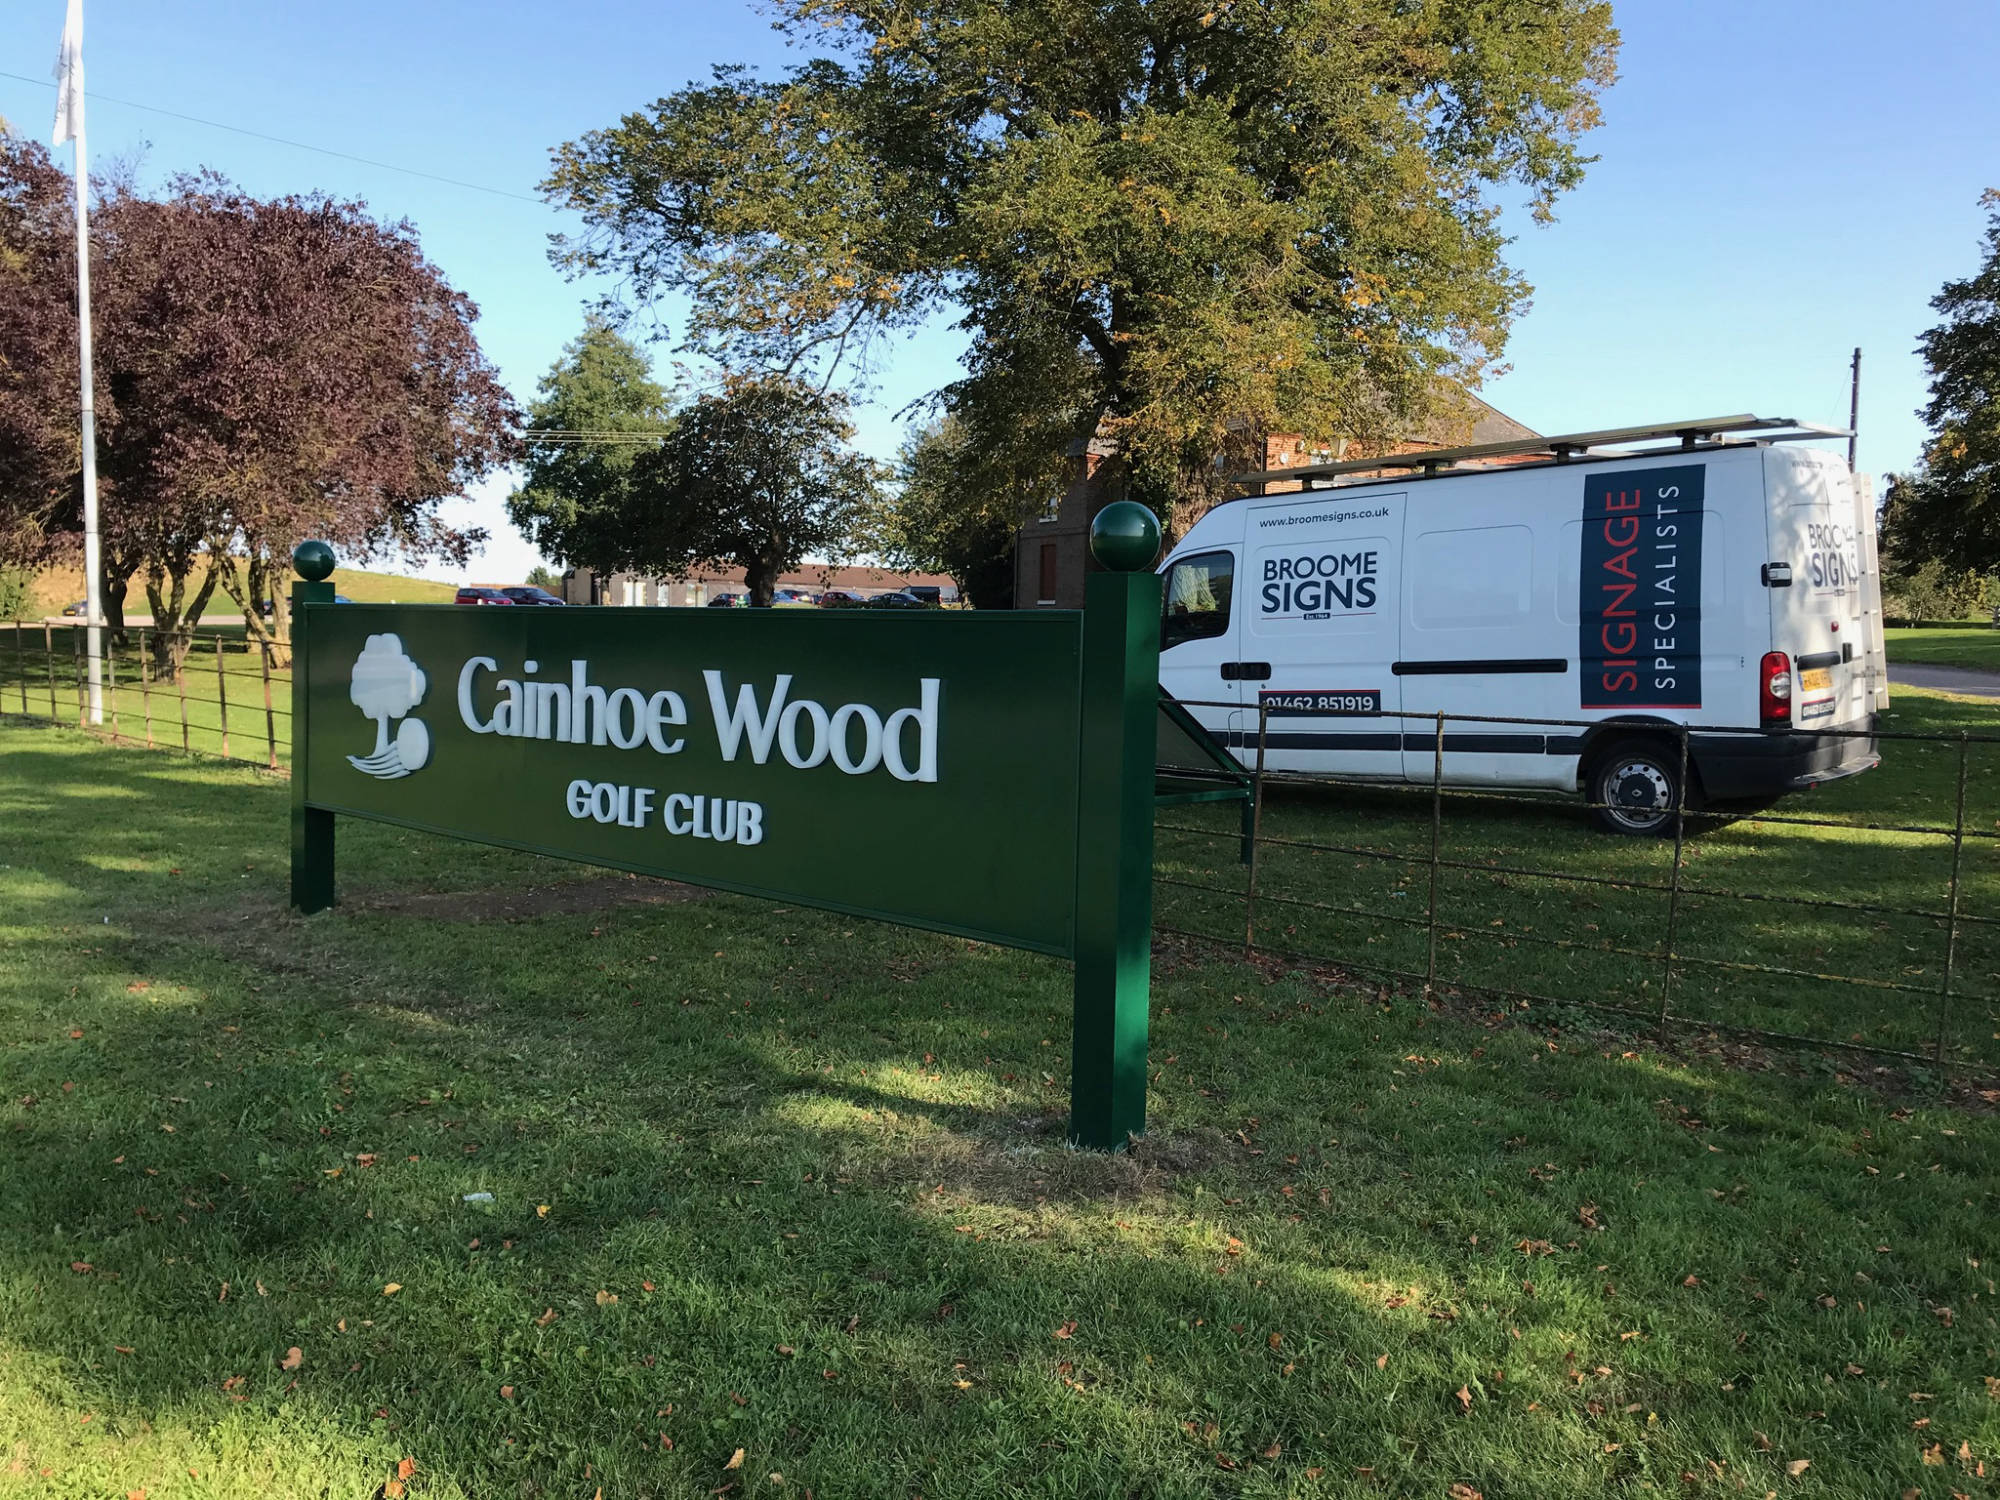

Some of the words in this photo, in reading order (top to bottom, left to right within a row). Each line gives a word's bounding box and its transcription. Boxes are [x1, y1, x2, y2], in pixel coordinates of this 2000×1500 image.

[1259, 507, 1389, 528] www.broomesigns.co.uk
[1263, 551, 1378, 582] BROOME
[1811, 551, 1859, 588] SIGNS
[1261, 577, 1377, 613] SIGNS
[1602, 489, 1641, 692] SIGNAGE
[1653, 485, 1680, 690] SPECIALISTS
[458, 656, 687, 755] Cainhoe
[702, 669, 941, 784] Wood
[1318, 696, 1374, 711] 851919
[566, 779, 656, 829] GOLF
[663, 793, 764, 846] CLUB
